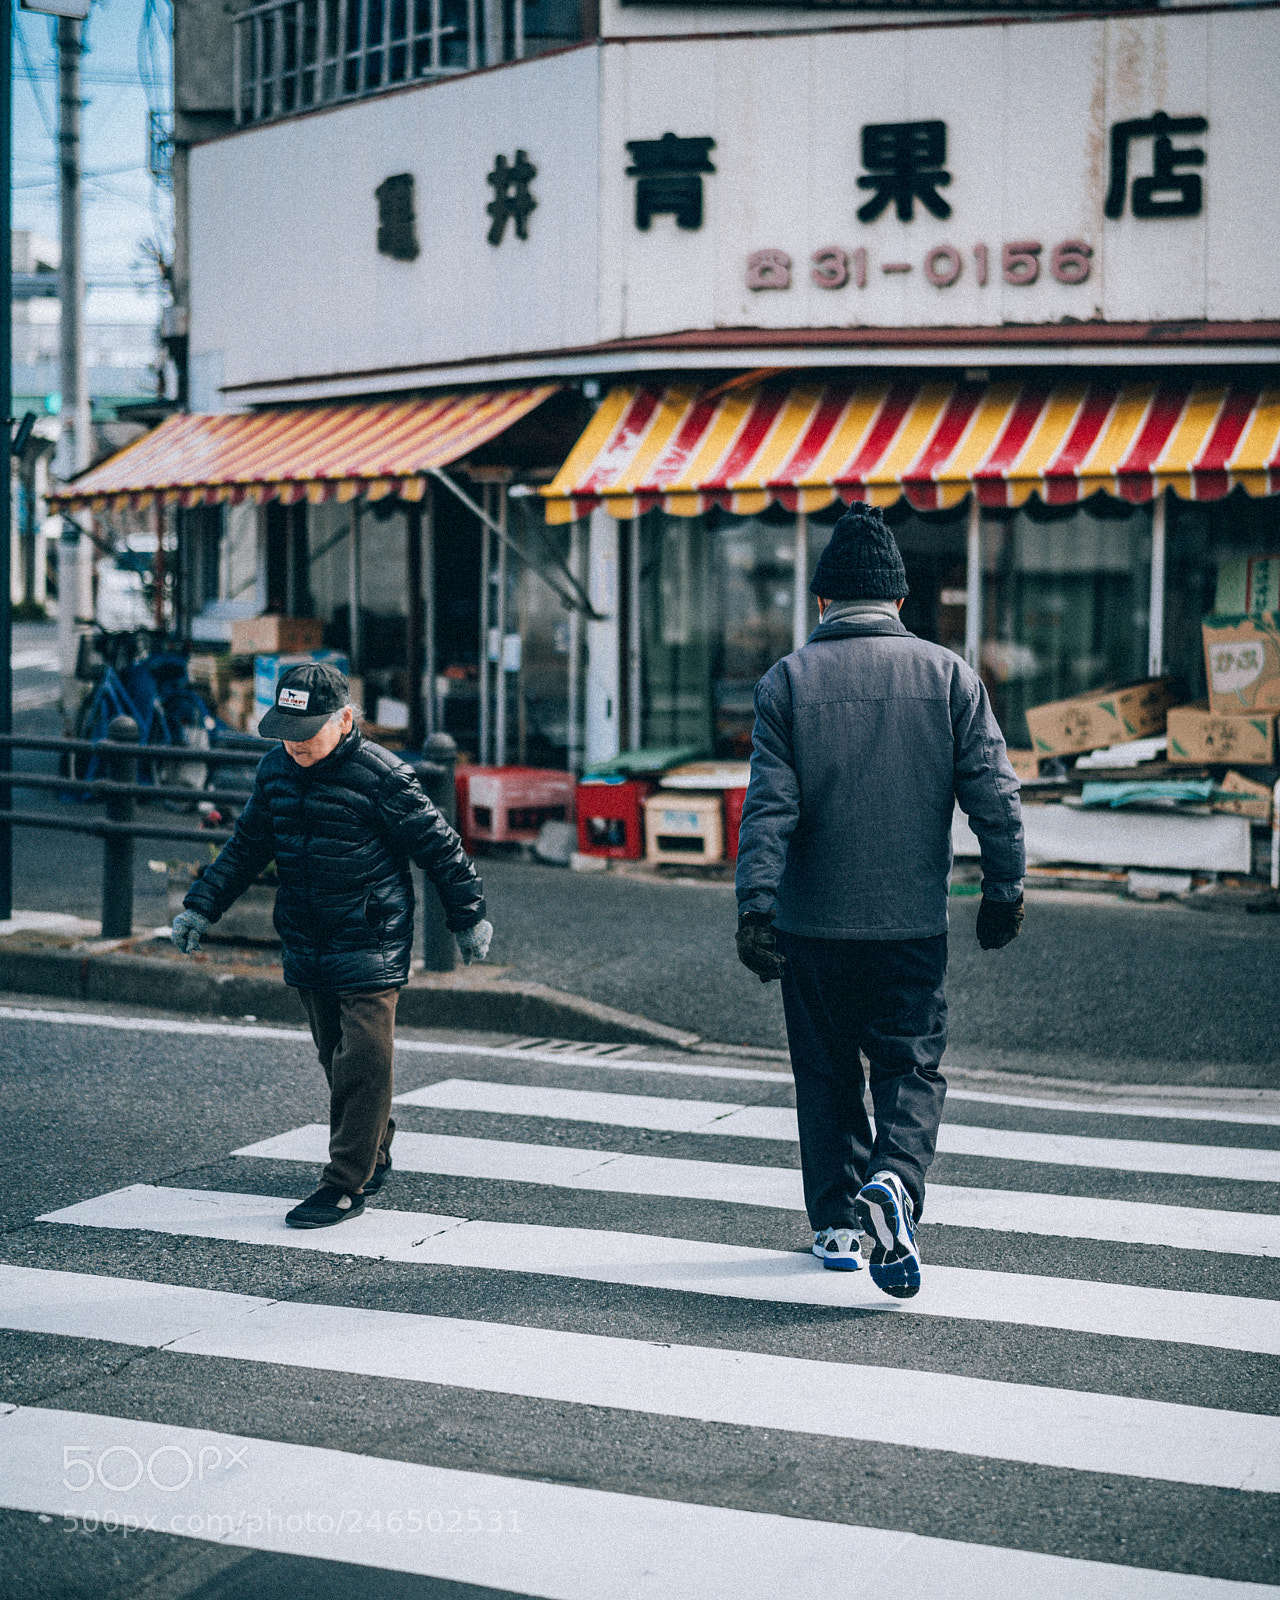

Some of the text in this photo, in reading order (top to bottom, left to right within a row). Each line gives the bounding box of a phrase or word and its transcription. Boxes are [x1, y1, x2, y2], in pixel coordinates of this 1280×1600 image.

[624, 109, 1210, 232] 青果店
[811, 239, 1093, 289] 31-0156
